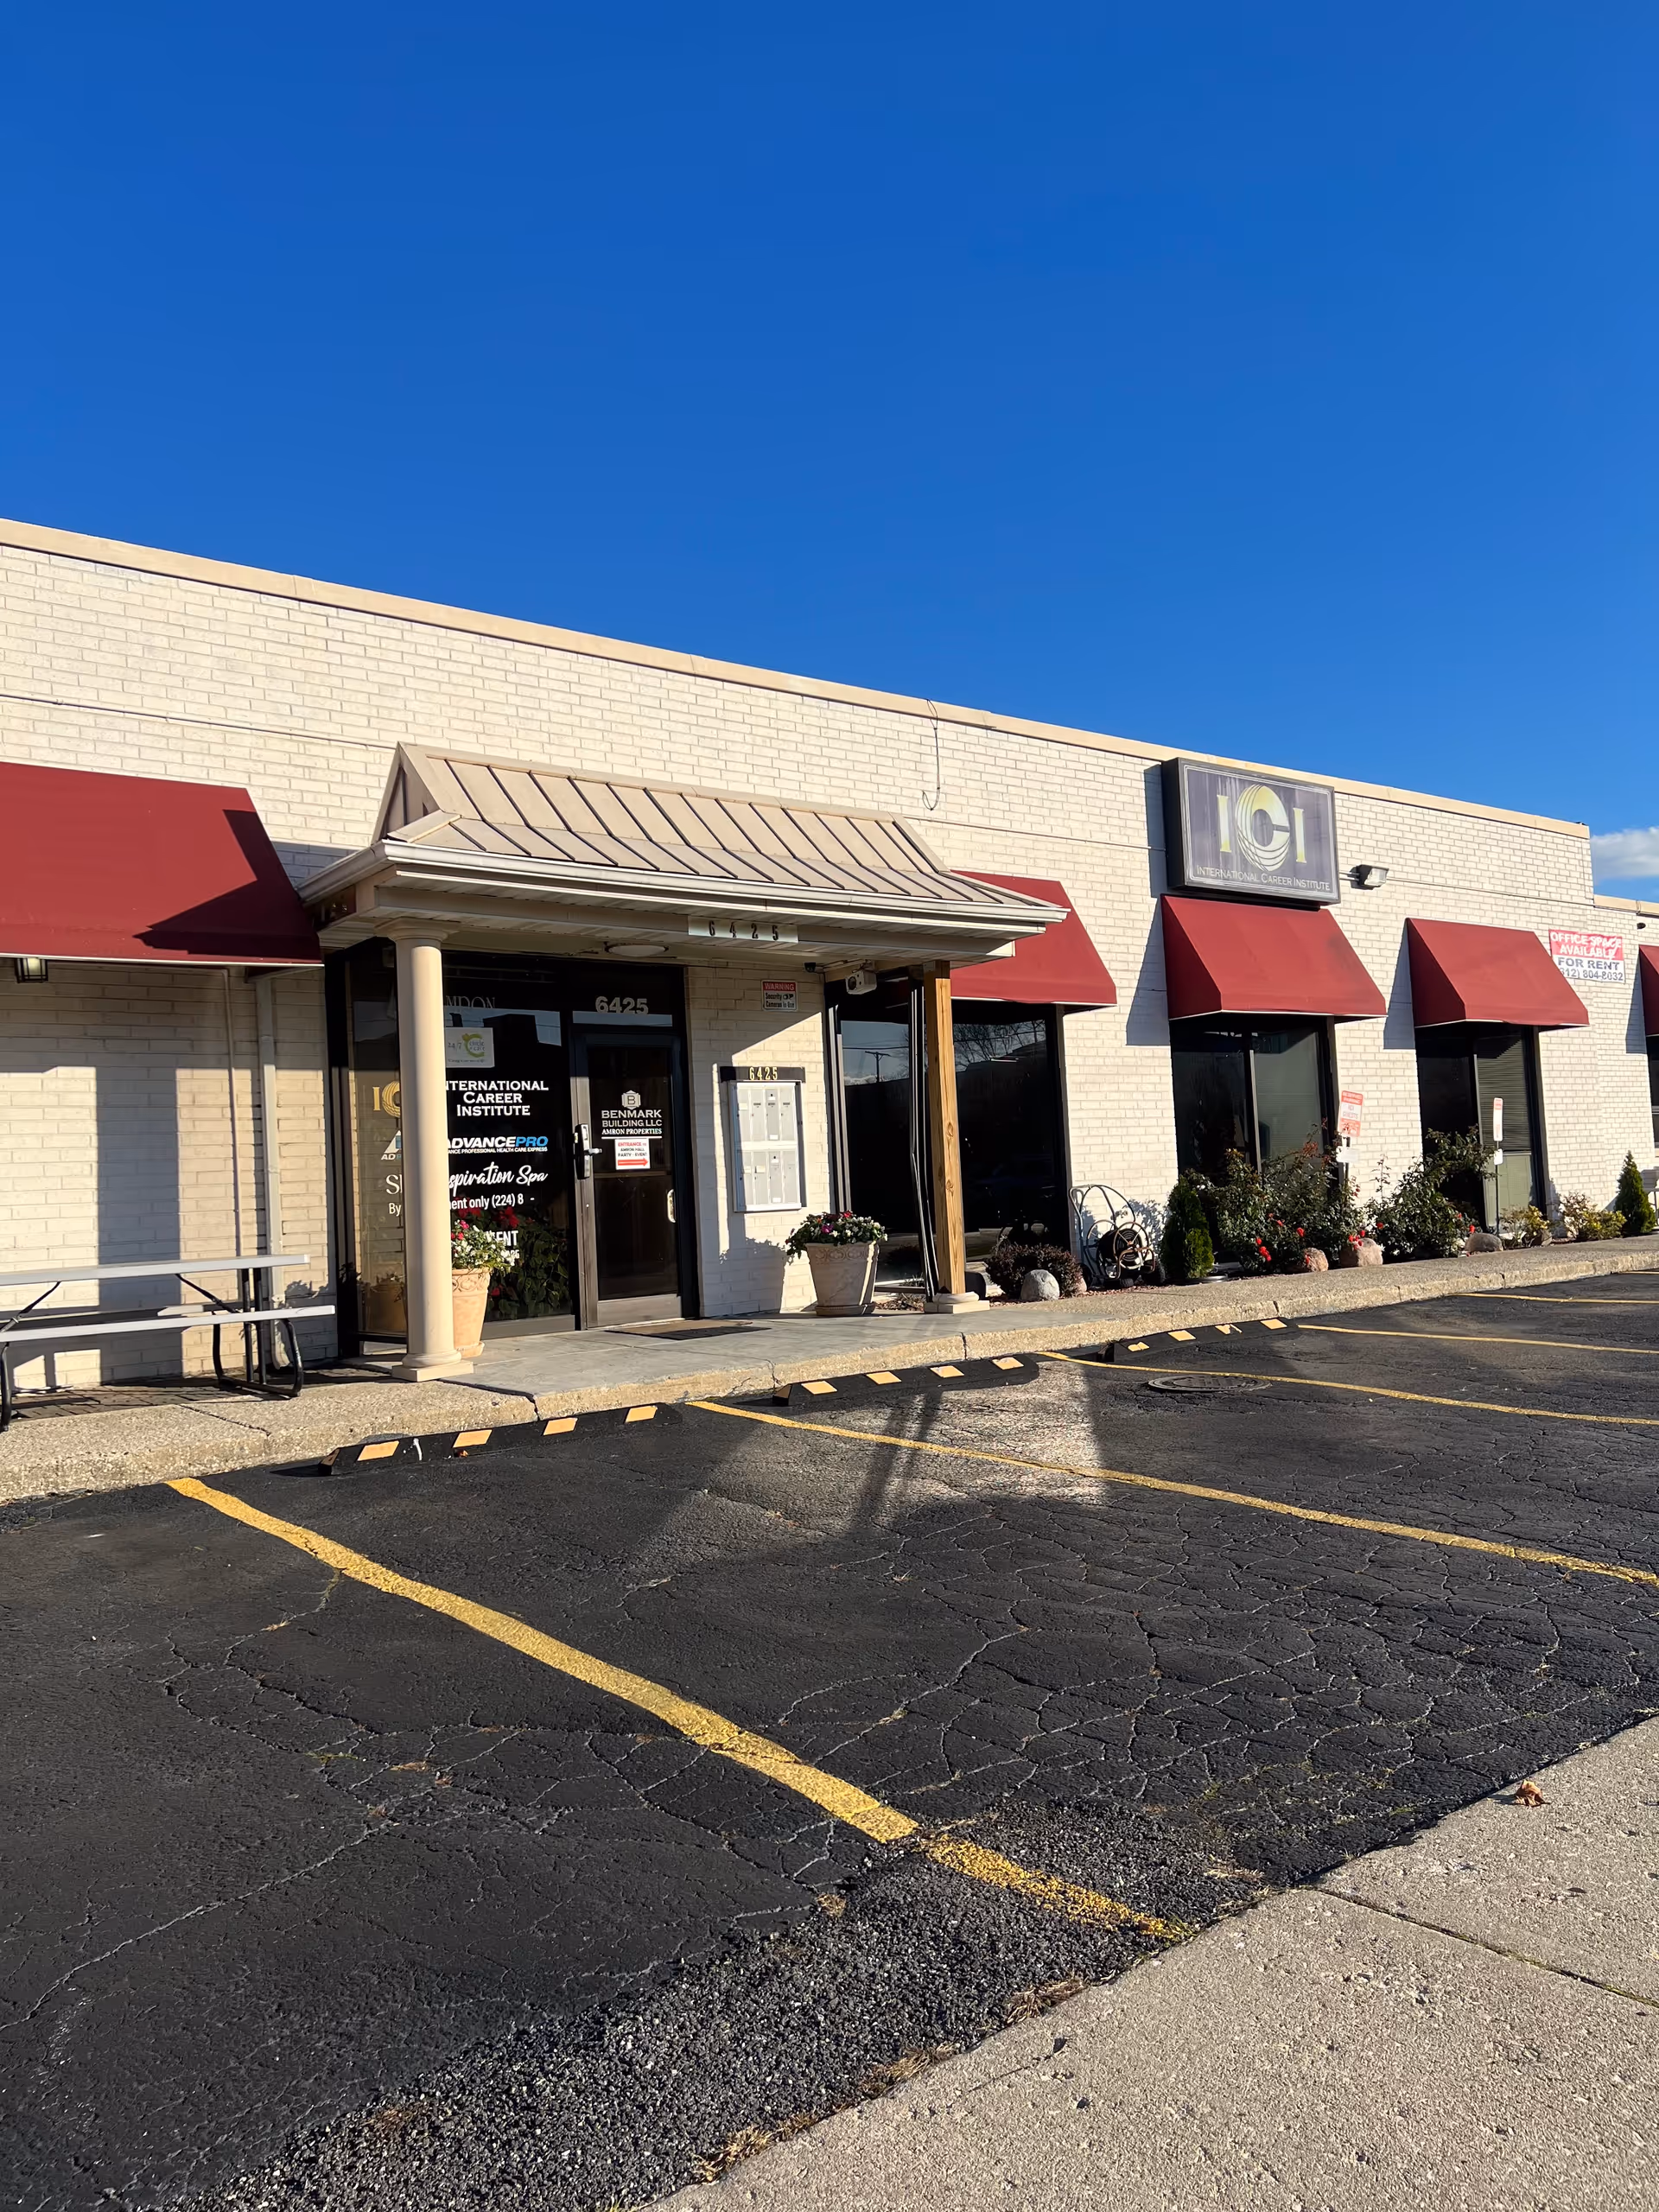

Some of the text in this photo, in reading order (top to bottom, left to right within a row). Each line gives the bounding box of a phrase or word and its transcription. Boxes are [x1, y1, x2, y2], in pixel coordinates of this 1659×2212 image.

[1217, 784, 1307, 872] ICI
[1197, 866, 1331, 891] INTERNATIONAL CAREER INSTITUTE
[708, 920, 780, 941] 6425
[1549, 931, 1589, 945] OFFICE
[1557, 957, 1620, 971] FOR RENT
[764, 982, 795, 991] WARNING
[594, 995, 650, 1015] 6425
[749, 1066, 779, 1081] 6425
[445, 1080, 550, 1091] TERNATIONAL
[463, 1091, 523, 1104] CAREER
[456, 1104, 531, 1116] INSTITUTE
[601, 1109, 662, 1119] BENMARK
[448, 1136, 549, 1149] DVANCEPRO
[516, 1165, 549, 1186] Spa
[389, 1202, 402, 1217] By
[468, 1195, 490, 1211] only
[491, 1192, 516, 1209] (224)
